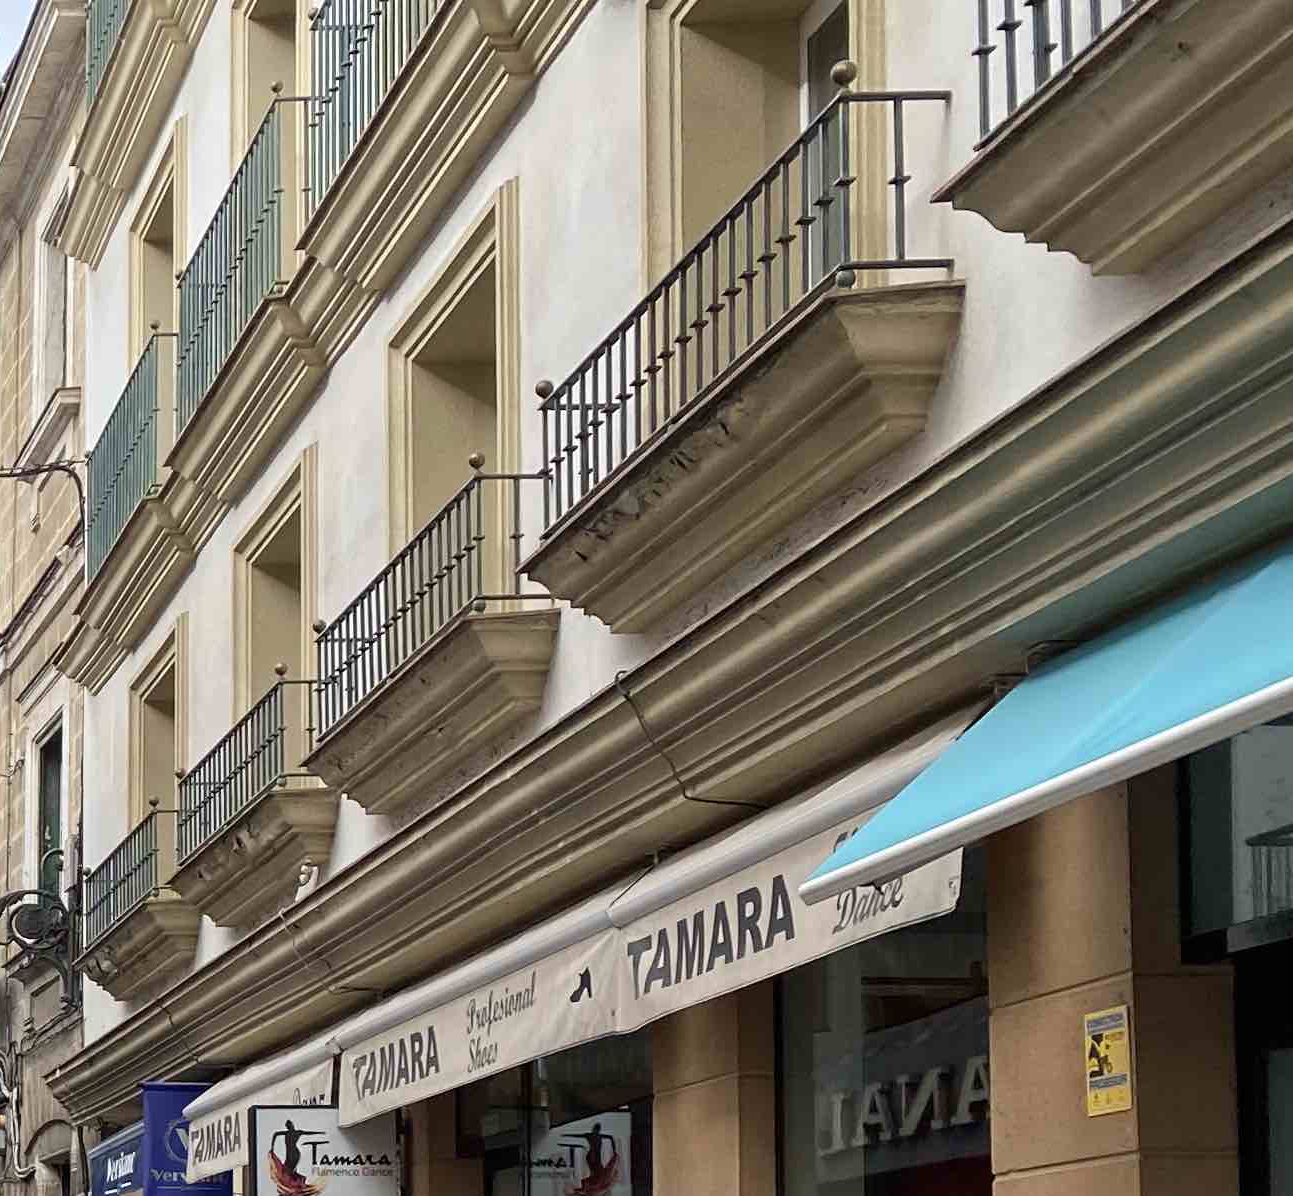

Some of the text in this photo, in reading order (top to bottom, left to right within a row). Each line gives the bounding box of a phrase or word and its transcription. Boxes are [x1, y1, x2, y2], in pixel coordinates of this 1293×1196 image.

[627, 873, 795, 1000] TAMARA
[466, 969, 537, 1034] Profesional
[352, 1025, 440, 1101] TAMARA
[466, 1038, 499, 1074] Shoes
[190, 1111, 242, 1166] TAMARA
[301, 1140, 392, 1167] Tamara
